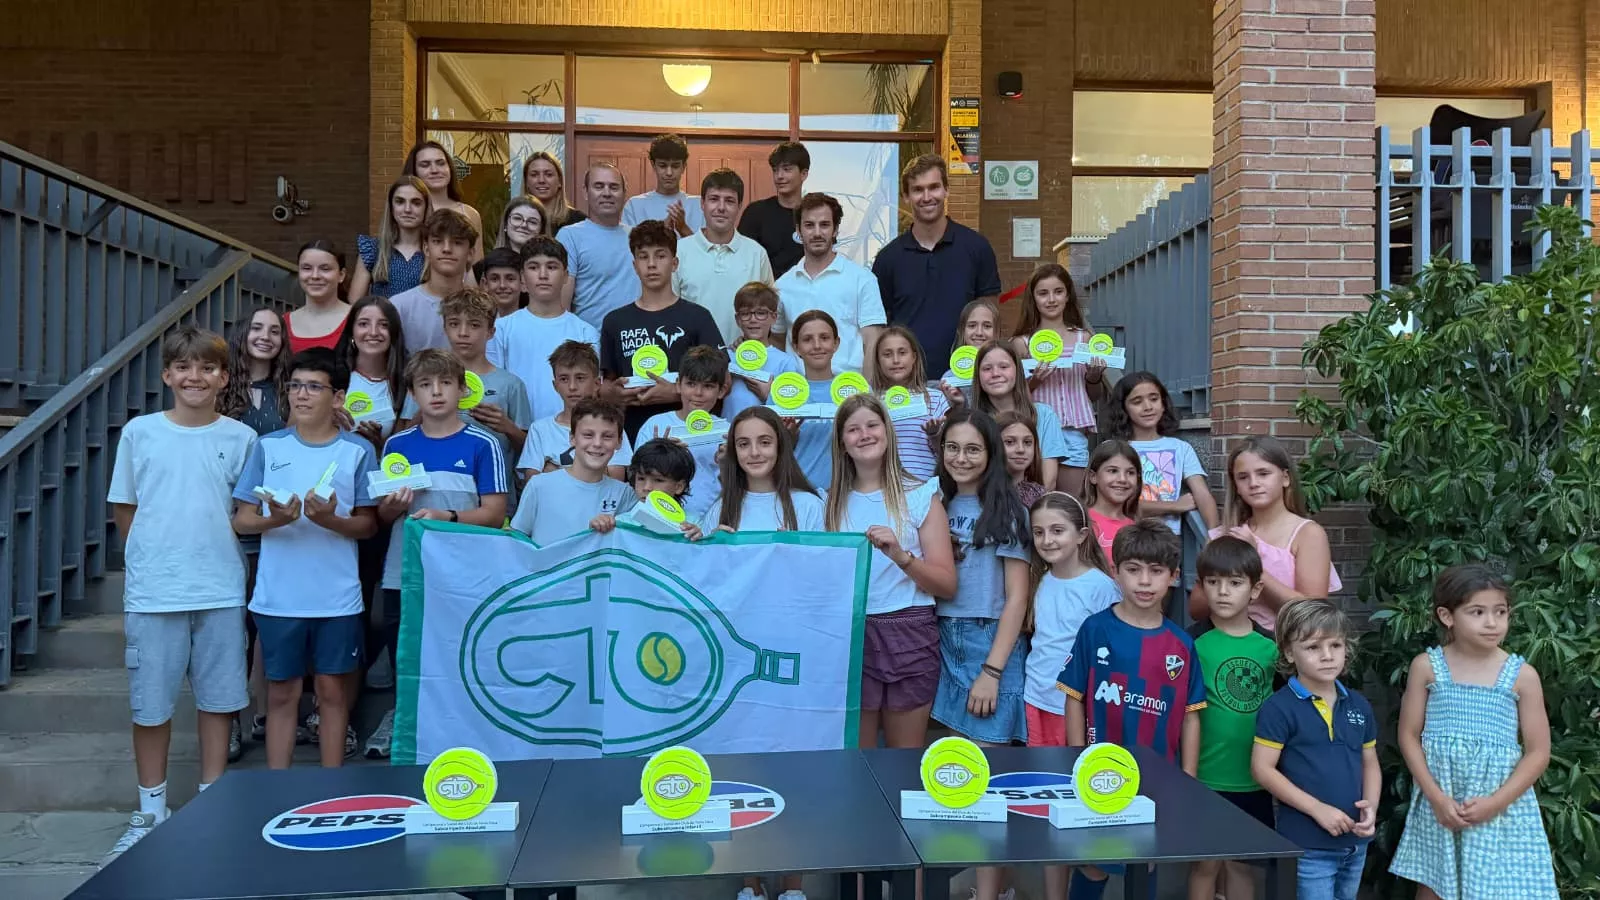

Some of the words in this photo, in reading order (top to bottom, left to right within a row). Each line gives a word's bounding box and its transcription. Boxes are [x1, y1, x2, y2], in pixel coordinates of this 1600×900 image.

[620, 327, 649, 340] RAFA
[622, 337, 659, 350] NADAL
[1124, 692, 1166, 712] aramon
[274, 813, 406, 829] PEPS
